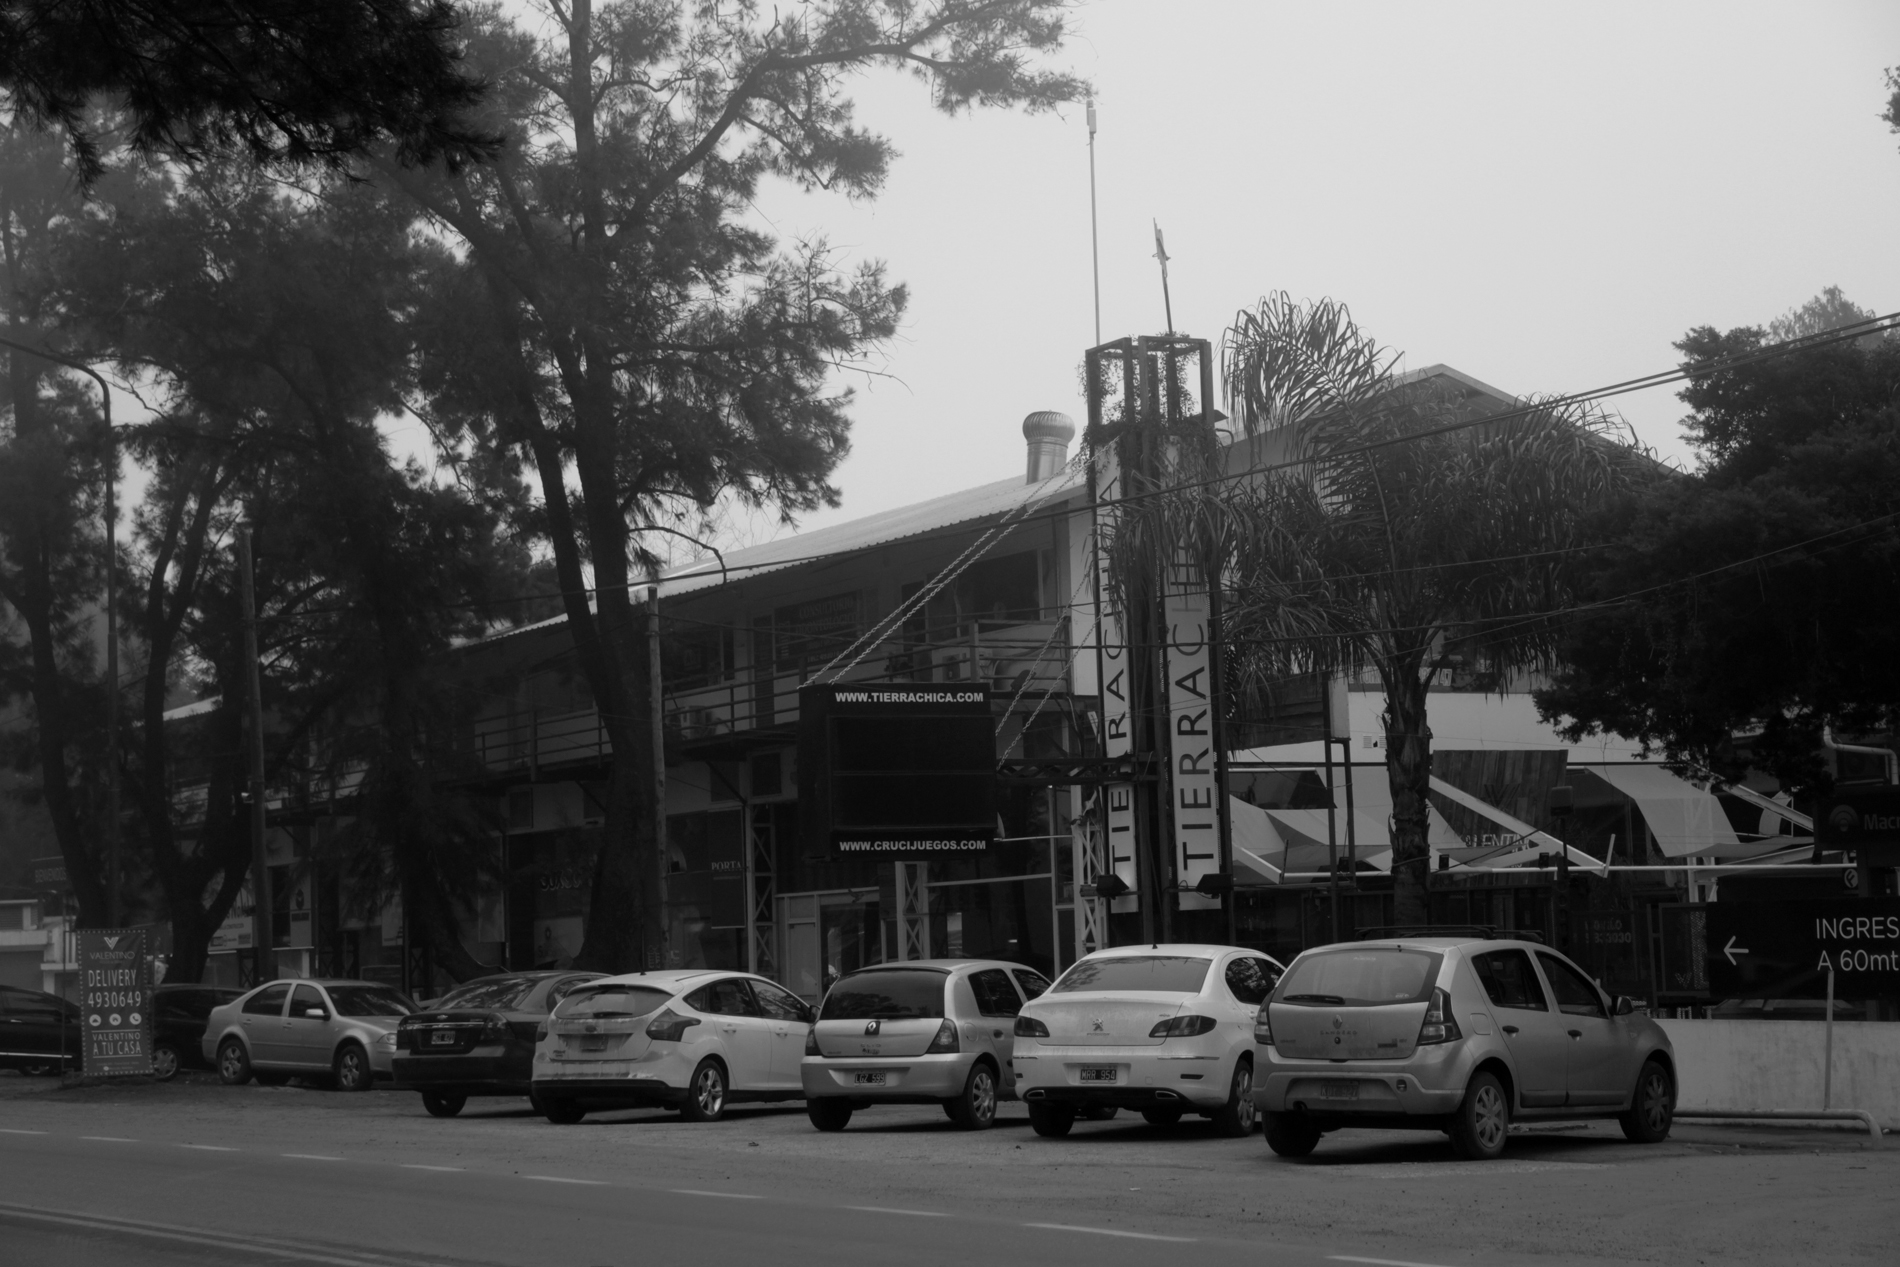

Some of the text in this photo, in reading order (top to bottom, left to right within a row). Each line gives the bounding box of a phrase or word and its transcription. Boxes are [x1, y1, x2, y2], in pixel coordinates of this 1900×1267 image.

[835, 692, 984, 703] WWW.TIERRACHICA.COM
[839, 840, 986, 851] WWW.CRUCIJUEGOS.COM
[1816, 916, 1900, 939] INGRES
[90, 951, 135, 960] VALENTINO
[1817, 949, 1900, 971] A 60mt
[88, 969, 137, 987] DELIVERY
[88, 991, 142, 1008] 4930649
[92, 1032, 141, 1041] VALENTINO
[93, 1041, 142, 1056] A TU CASA
[855, 1073, 885, 1083] LGZ 599
[1100, 1070, 1116, 1080] 954
